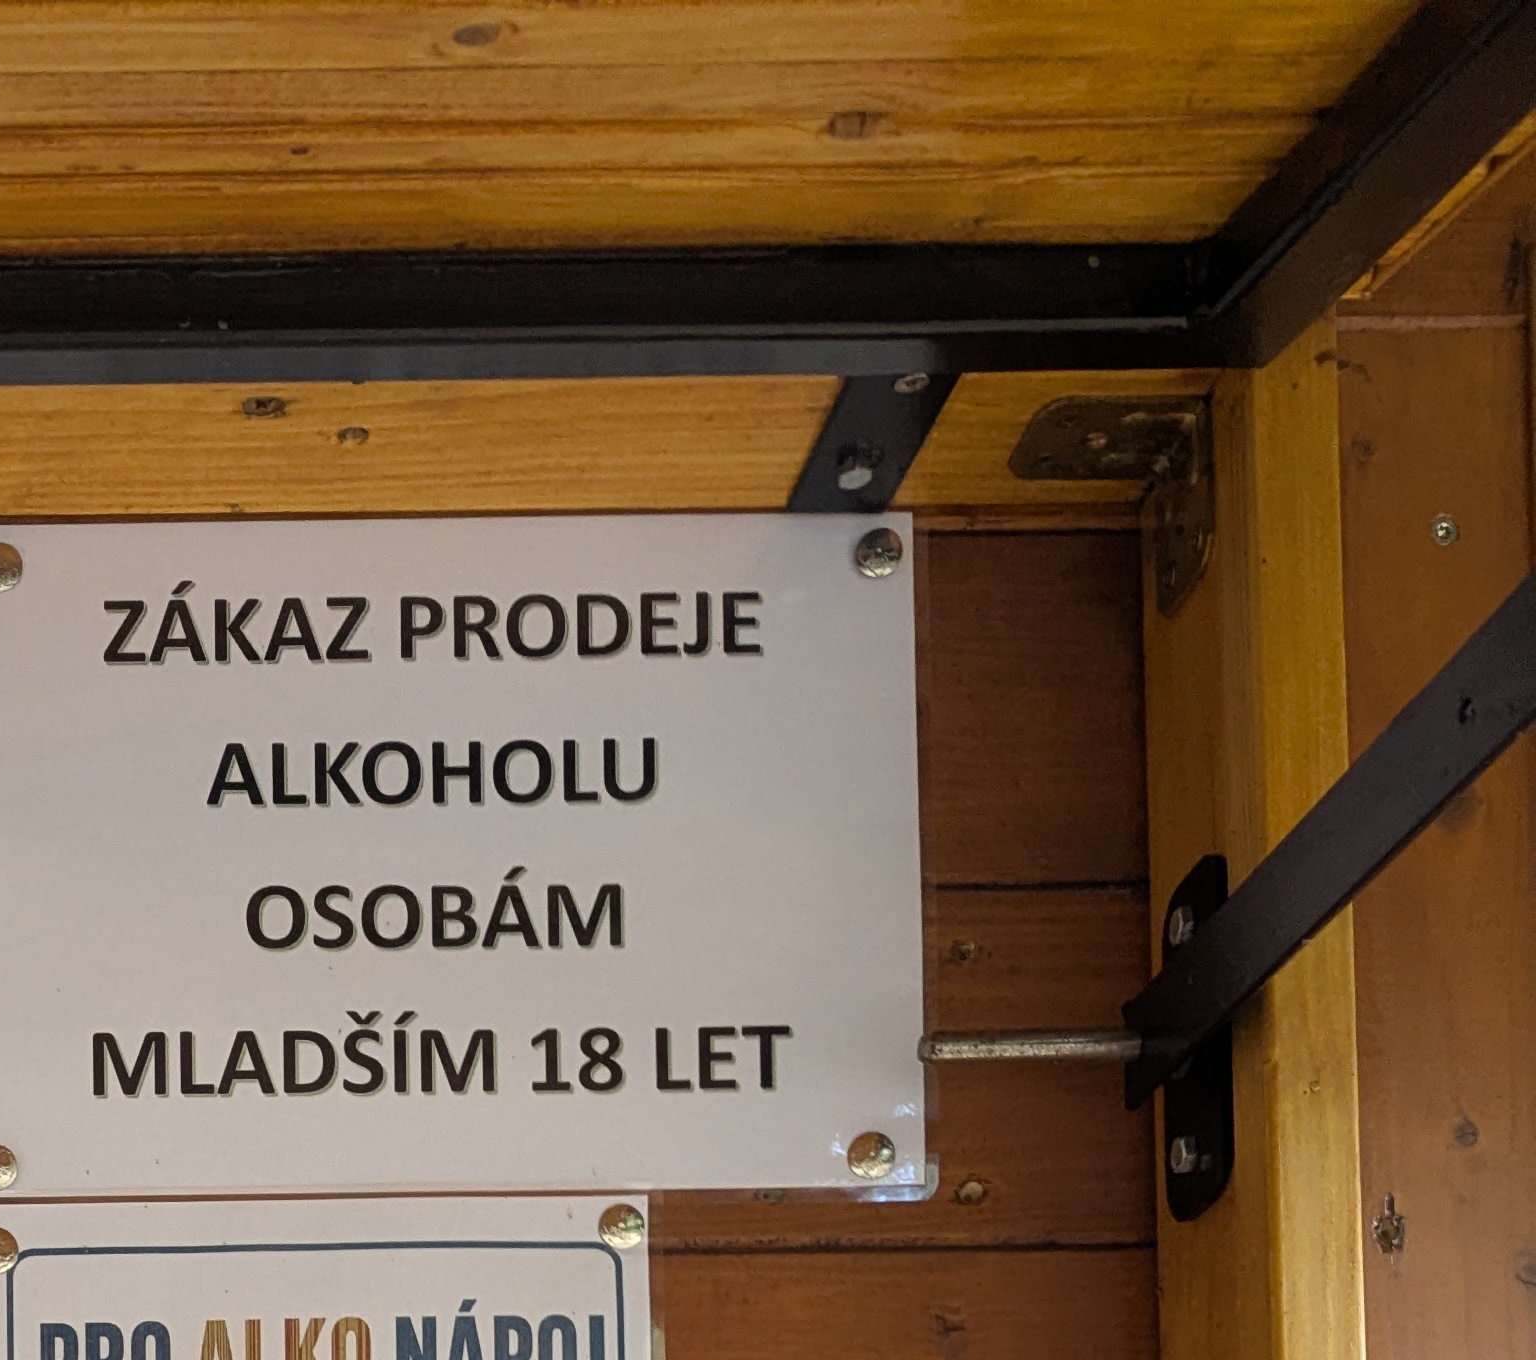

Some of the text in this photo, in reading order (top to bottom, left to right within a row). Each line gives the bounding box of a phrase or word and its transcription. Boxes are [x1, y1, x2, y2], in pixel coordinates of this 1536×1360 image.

[104, 581, 763, 665] ZÁKAZ PRODEJE
[207, 738, 655, 806] ALKOHOLU
[246, 866, 623, 949] OSOBÁM
[93, 1011, 793, 1096] MLADŠÍM 18 LET
